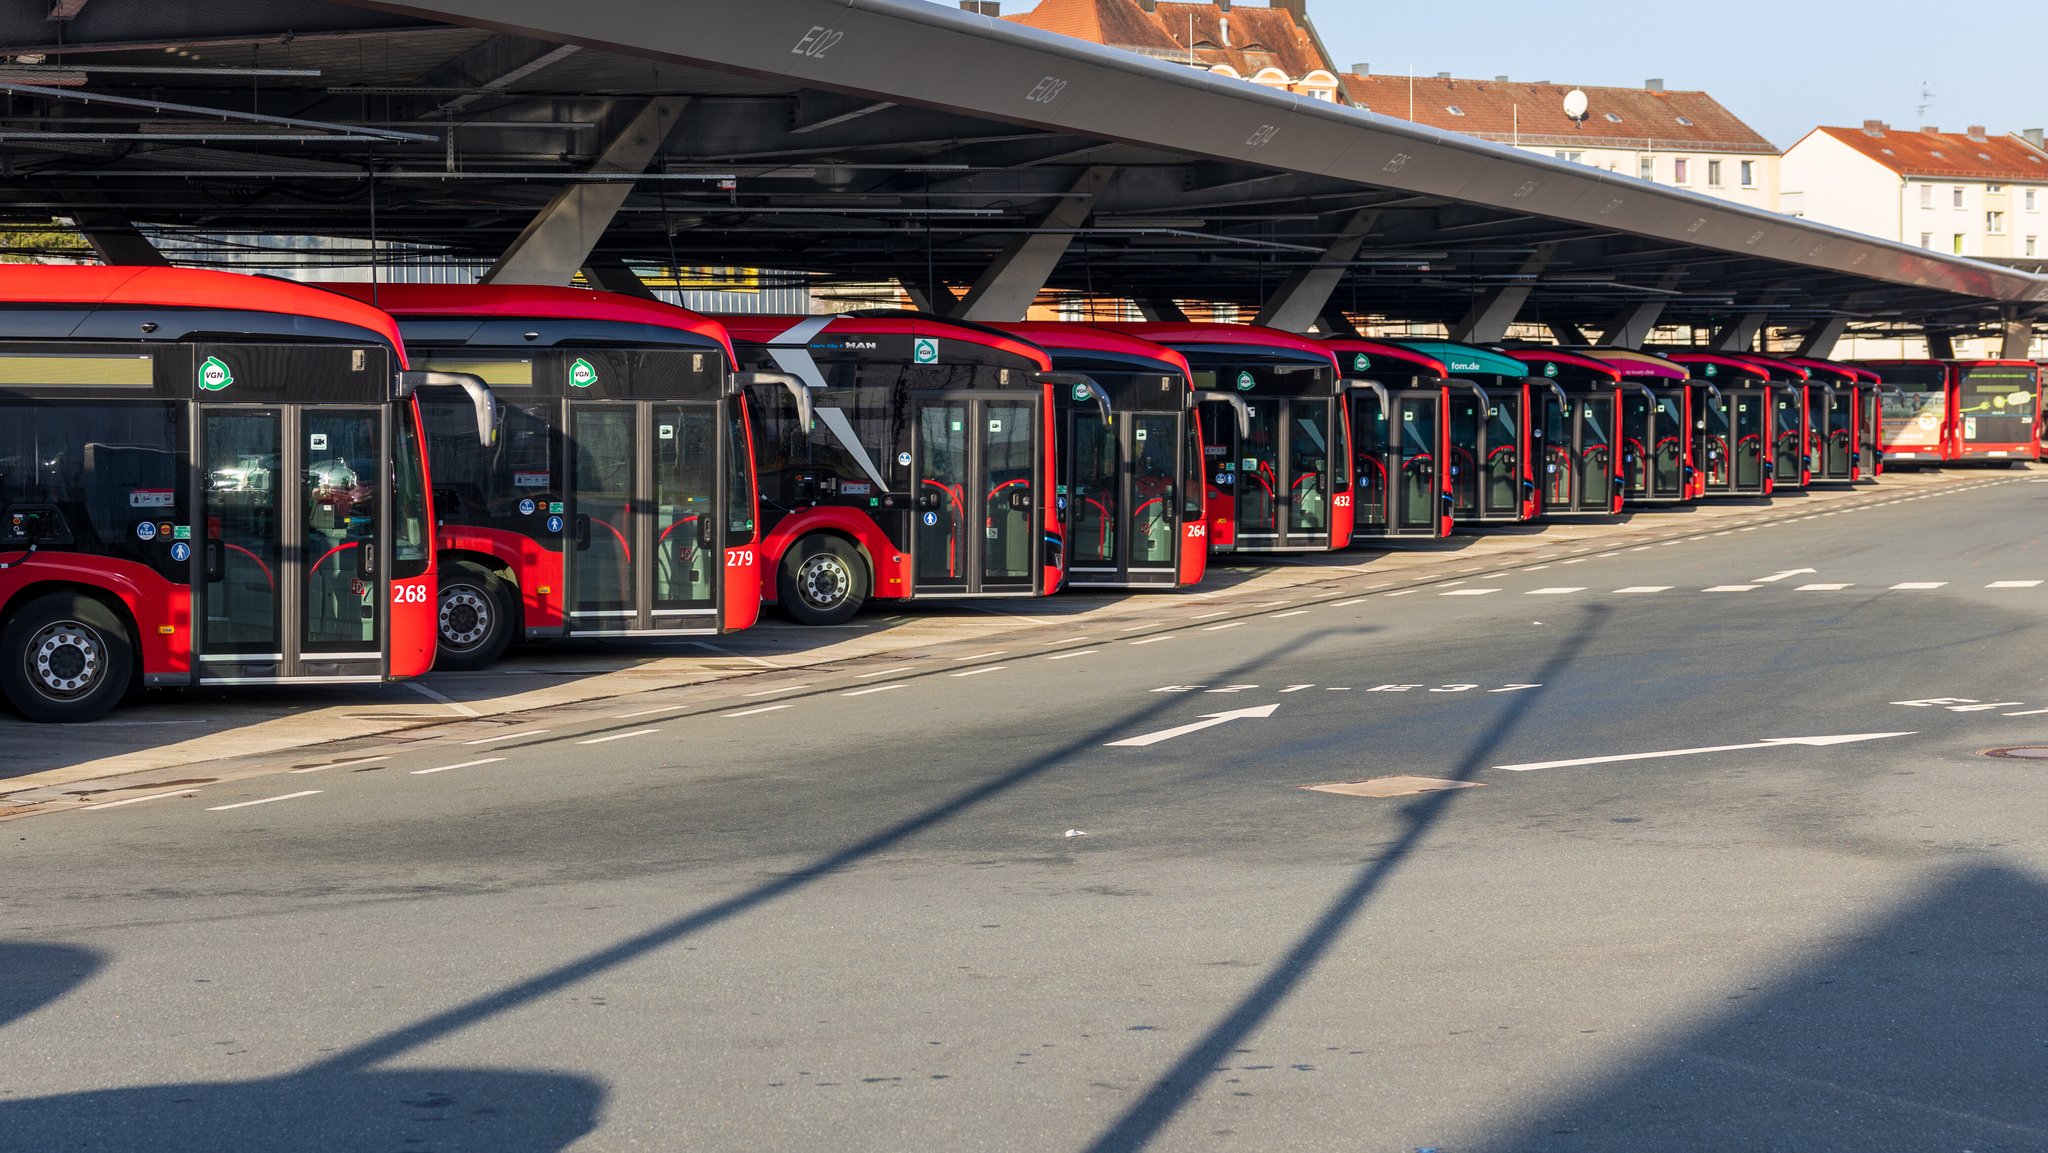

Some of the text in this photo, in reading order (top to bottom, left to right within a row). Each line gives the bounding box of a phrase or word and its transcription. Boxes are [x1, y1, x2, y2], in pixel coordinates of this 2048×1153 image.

[792, 26, 844, 59] E02
[1025, 76, 1067, 104] E03
[1245, 124, 1280, 147] E04
[1451, 362, 1480, 370] fom.de
[1334, 496, 1350, 506] 432
[1188, 525, 1205, 537] 264
[727, 551, 753, 566] 279
[394, 585, 426, 602] 268
